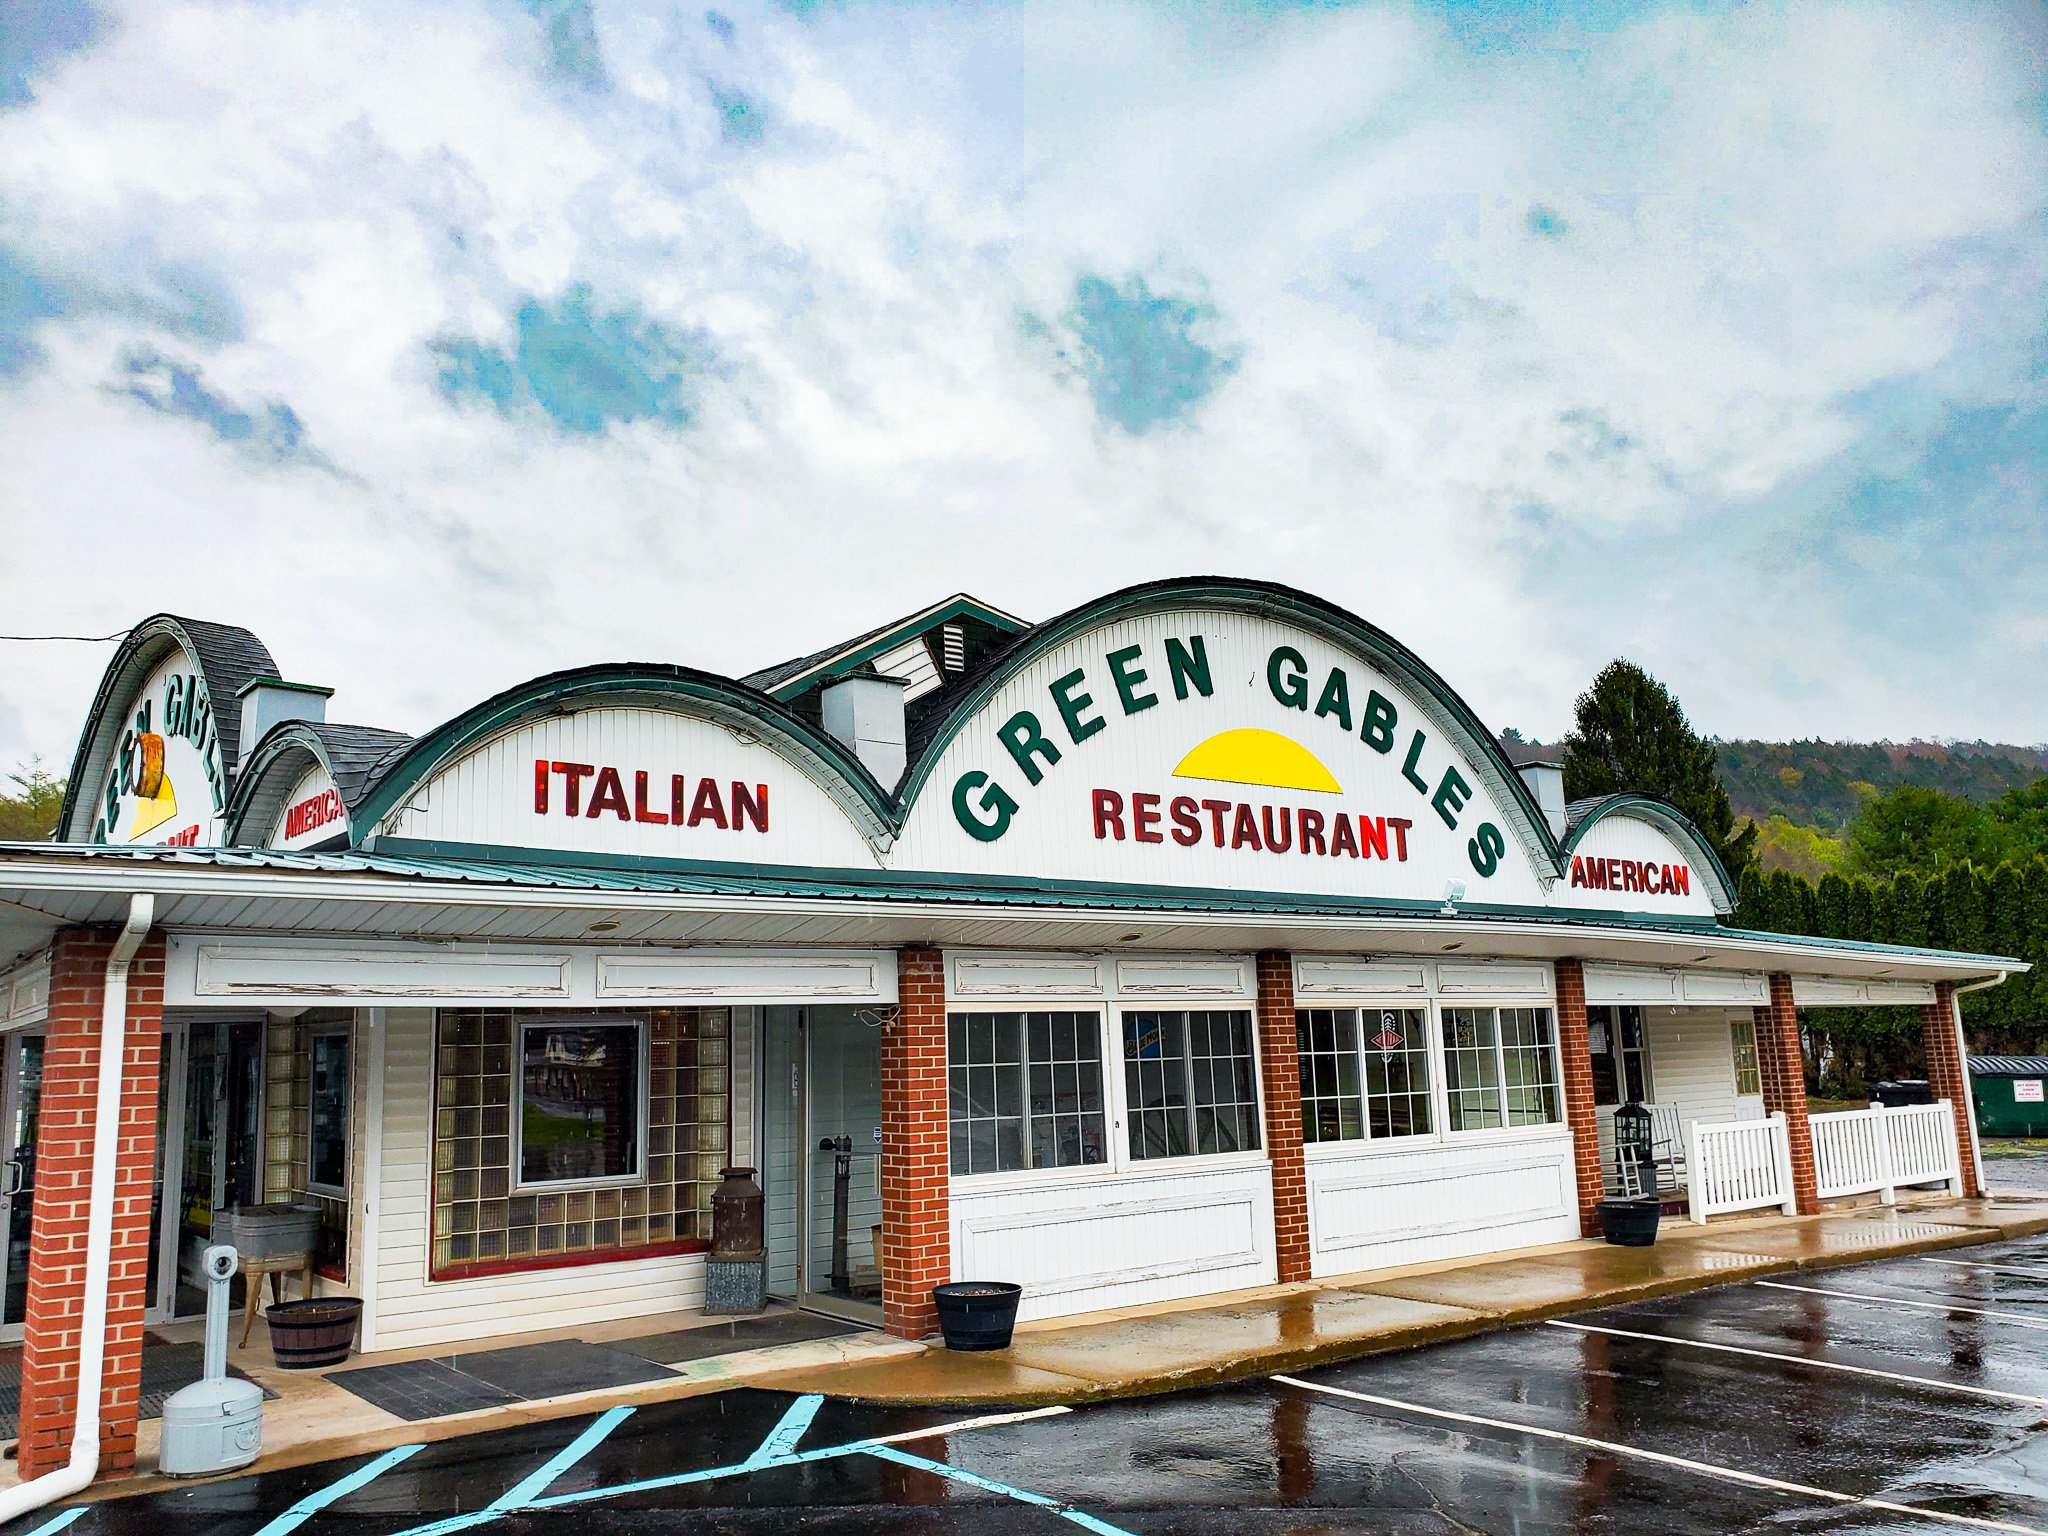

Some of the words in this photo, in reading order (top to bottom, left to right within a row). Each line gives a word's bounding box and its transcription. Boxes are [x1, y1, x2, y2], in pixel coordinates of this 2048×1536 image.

[951, 635, 1214, 842] GREEN
[1267, 645, 1506, 877] GABLES
[535, 759, 769, 833] ITALIAN
[1092, 788, 1412, 862] RESTAURANT
[1571, 855, 1690, 896] AMERICAN
